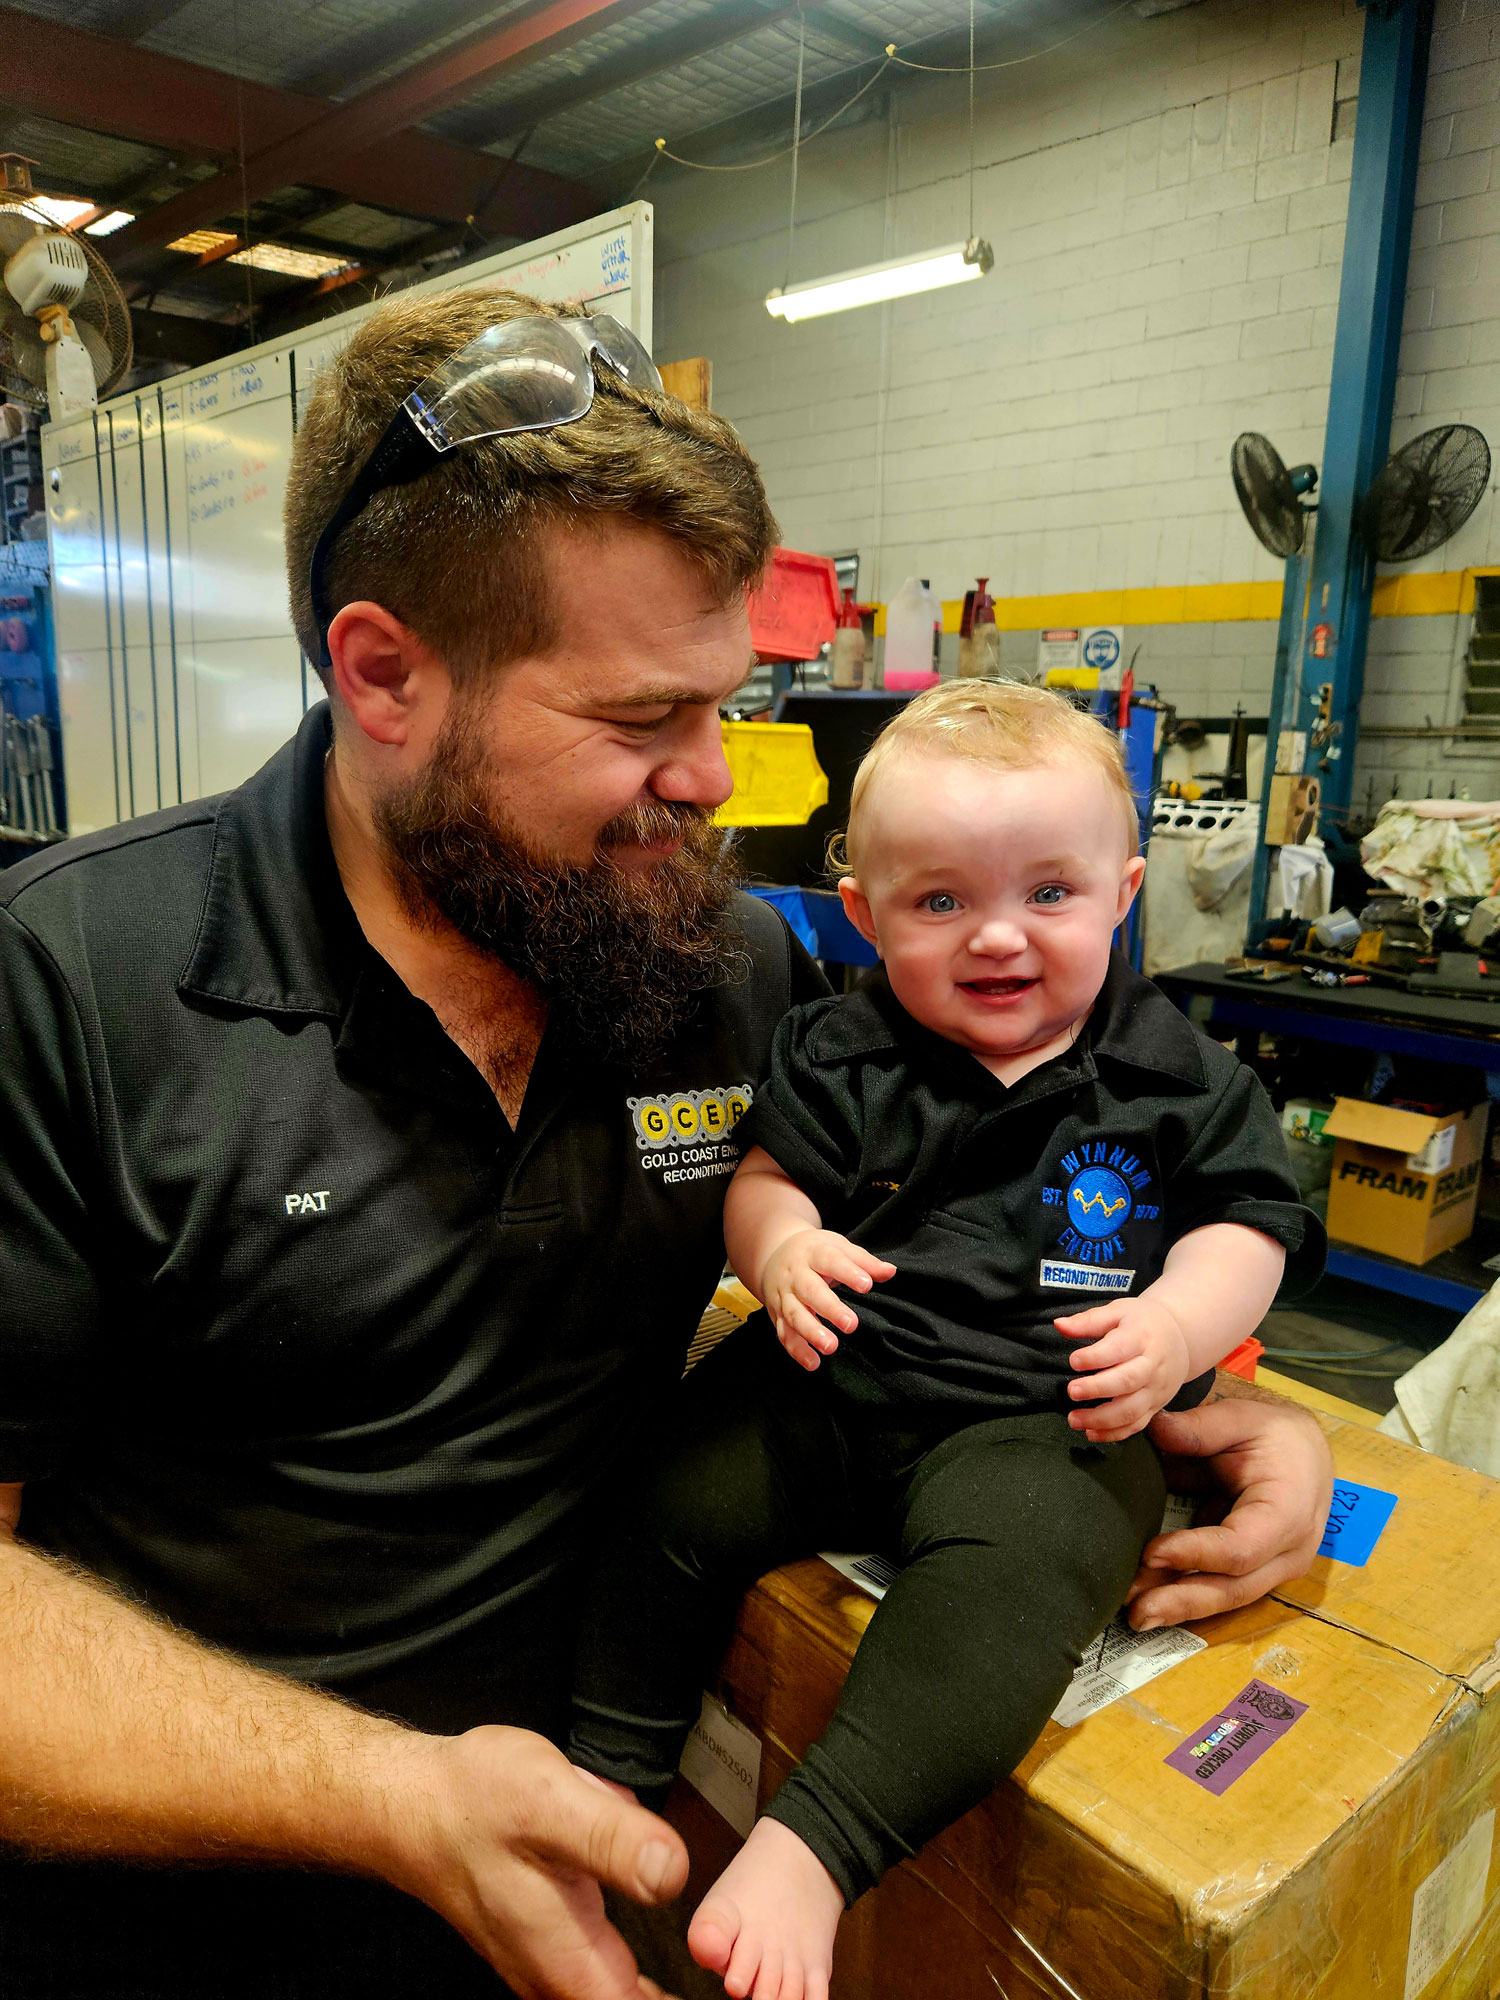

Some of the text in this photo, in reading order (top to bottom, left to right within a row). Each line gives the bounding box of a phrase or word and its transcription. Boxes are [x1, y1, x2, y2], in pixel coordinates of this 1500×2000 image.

[641, 1152, 679, 1170] GOLD
[681, 1145, 720, 1164] COAST
[1060, 1142, 1152, 1190] WYNNUM
[1338, 1160, 1429, 1201] FRAM
[285, 1190, 330, 1215] PAT
[1057, 1226, 1126, 1263] ENGINE
[1043, 1265, 1131, 1288] RECONDITIONING
[1195, 1746, 1234, 1779] CHECKED
